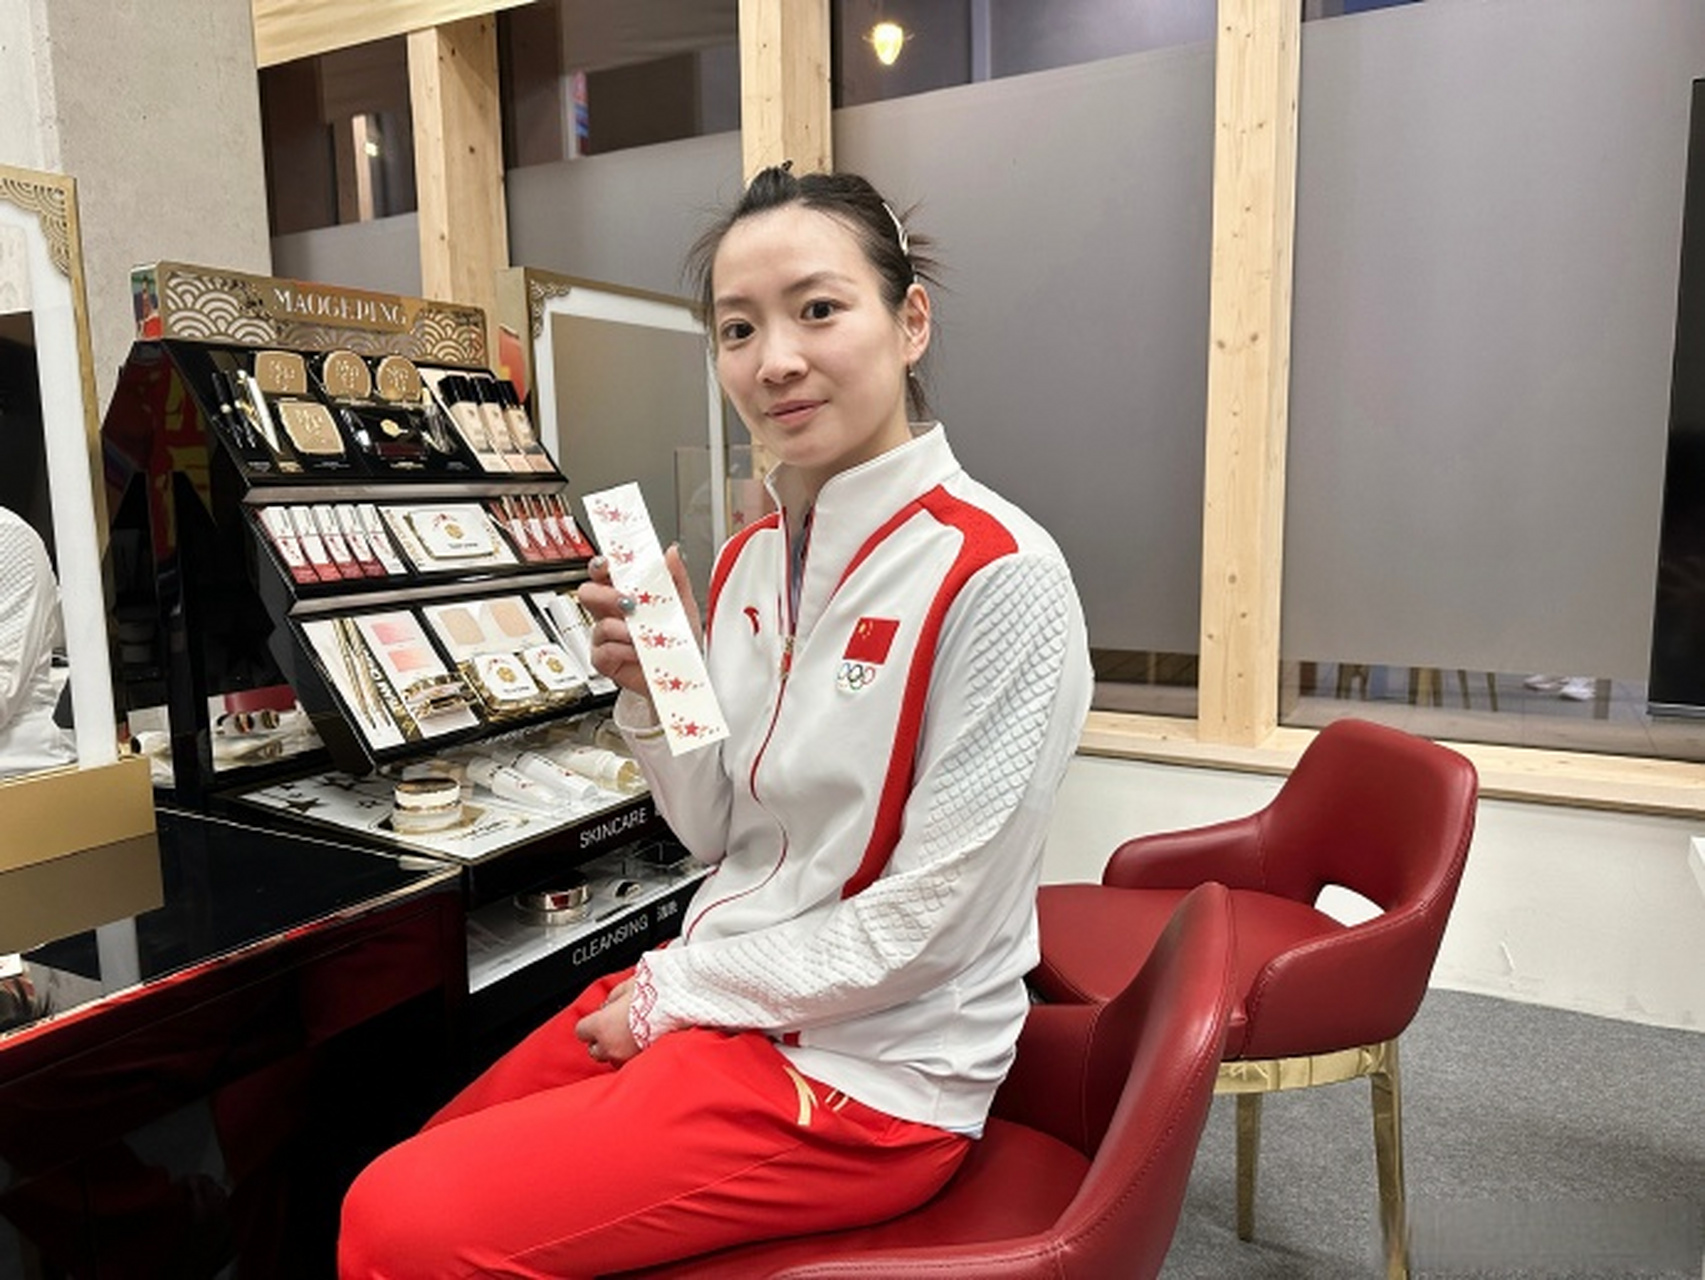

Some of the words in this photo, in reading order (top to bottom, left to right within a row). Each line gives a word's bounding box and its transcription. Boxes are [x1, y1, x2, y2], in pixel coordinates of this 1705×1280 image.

[273, 288, 407, 324] MAOGEPING
[579, 807, 648, 849] SKINCARE
[572, 913, 649, 966] CLEANSING
